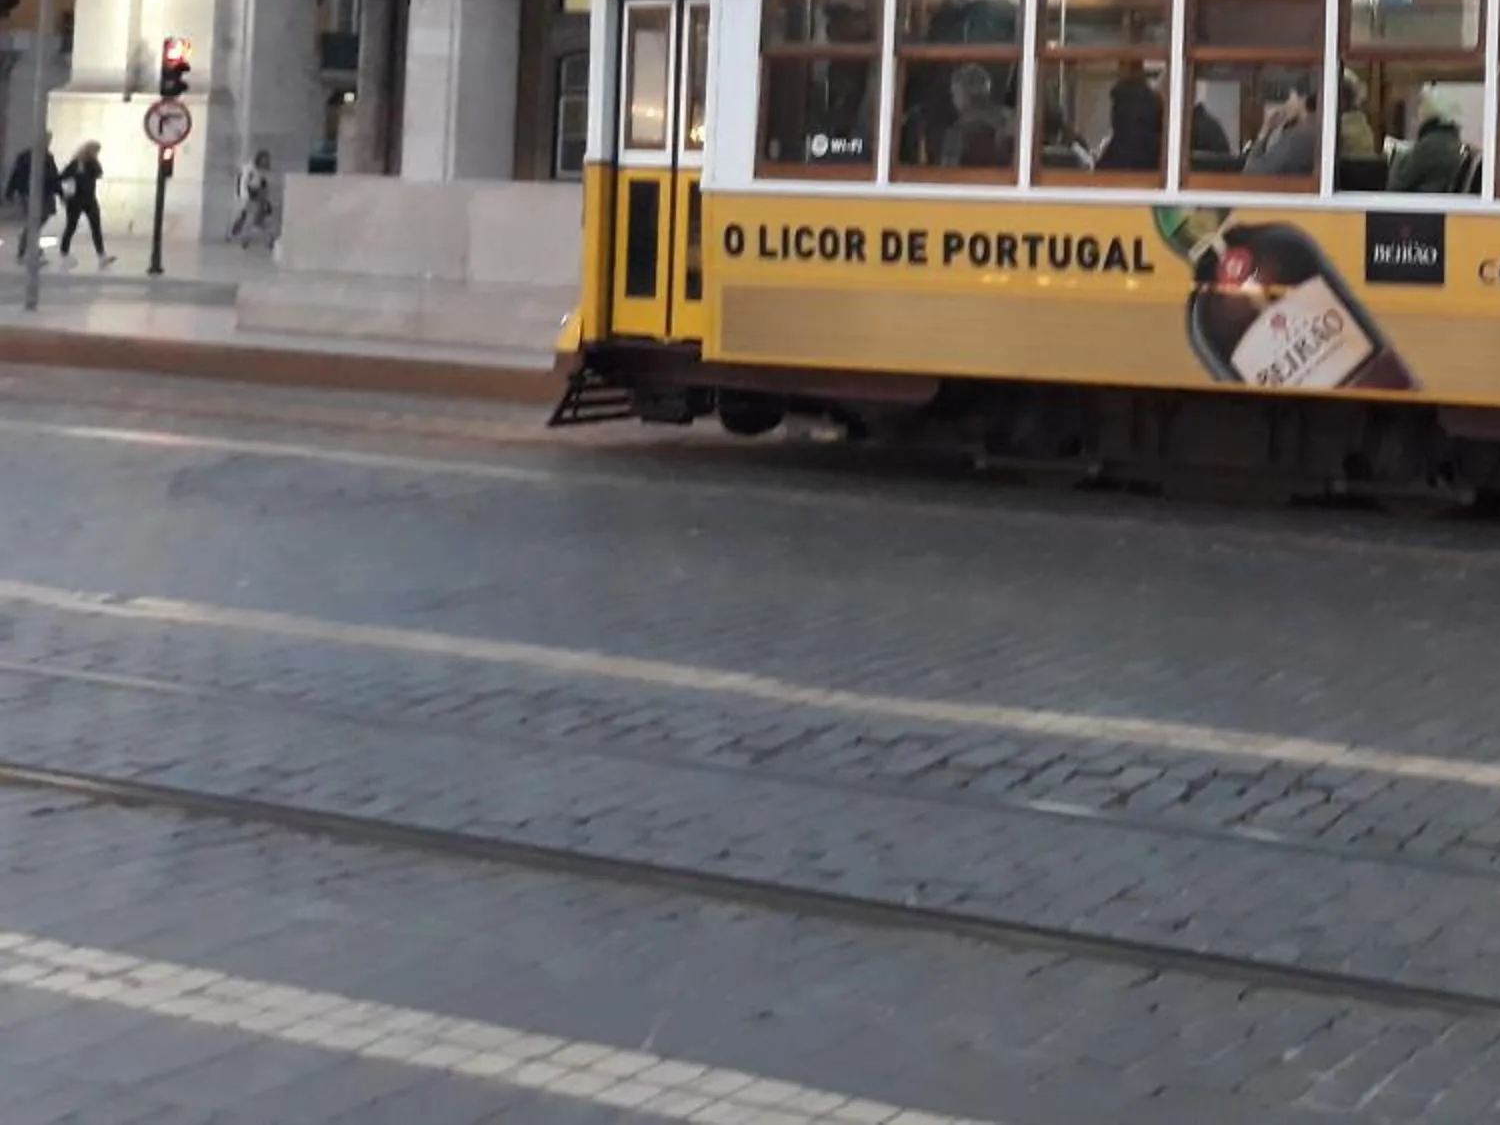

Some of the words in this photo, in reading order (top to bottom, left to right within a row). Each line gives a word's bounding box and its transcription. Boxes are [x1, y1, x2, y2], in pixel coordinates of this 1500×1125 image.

[724, 223, 745, 258] O
[758, 223, 867, 262] LICOR
[881, 229, 929, 264] DE
[943, 231, 1155, 273] PORTUGAL
